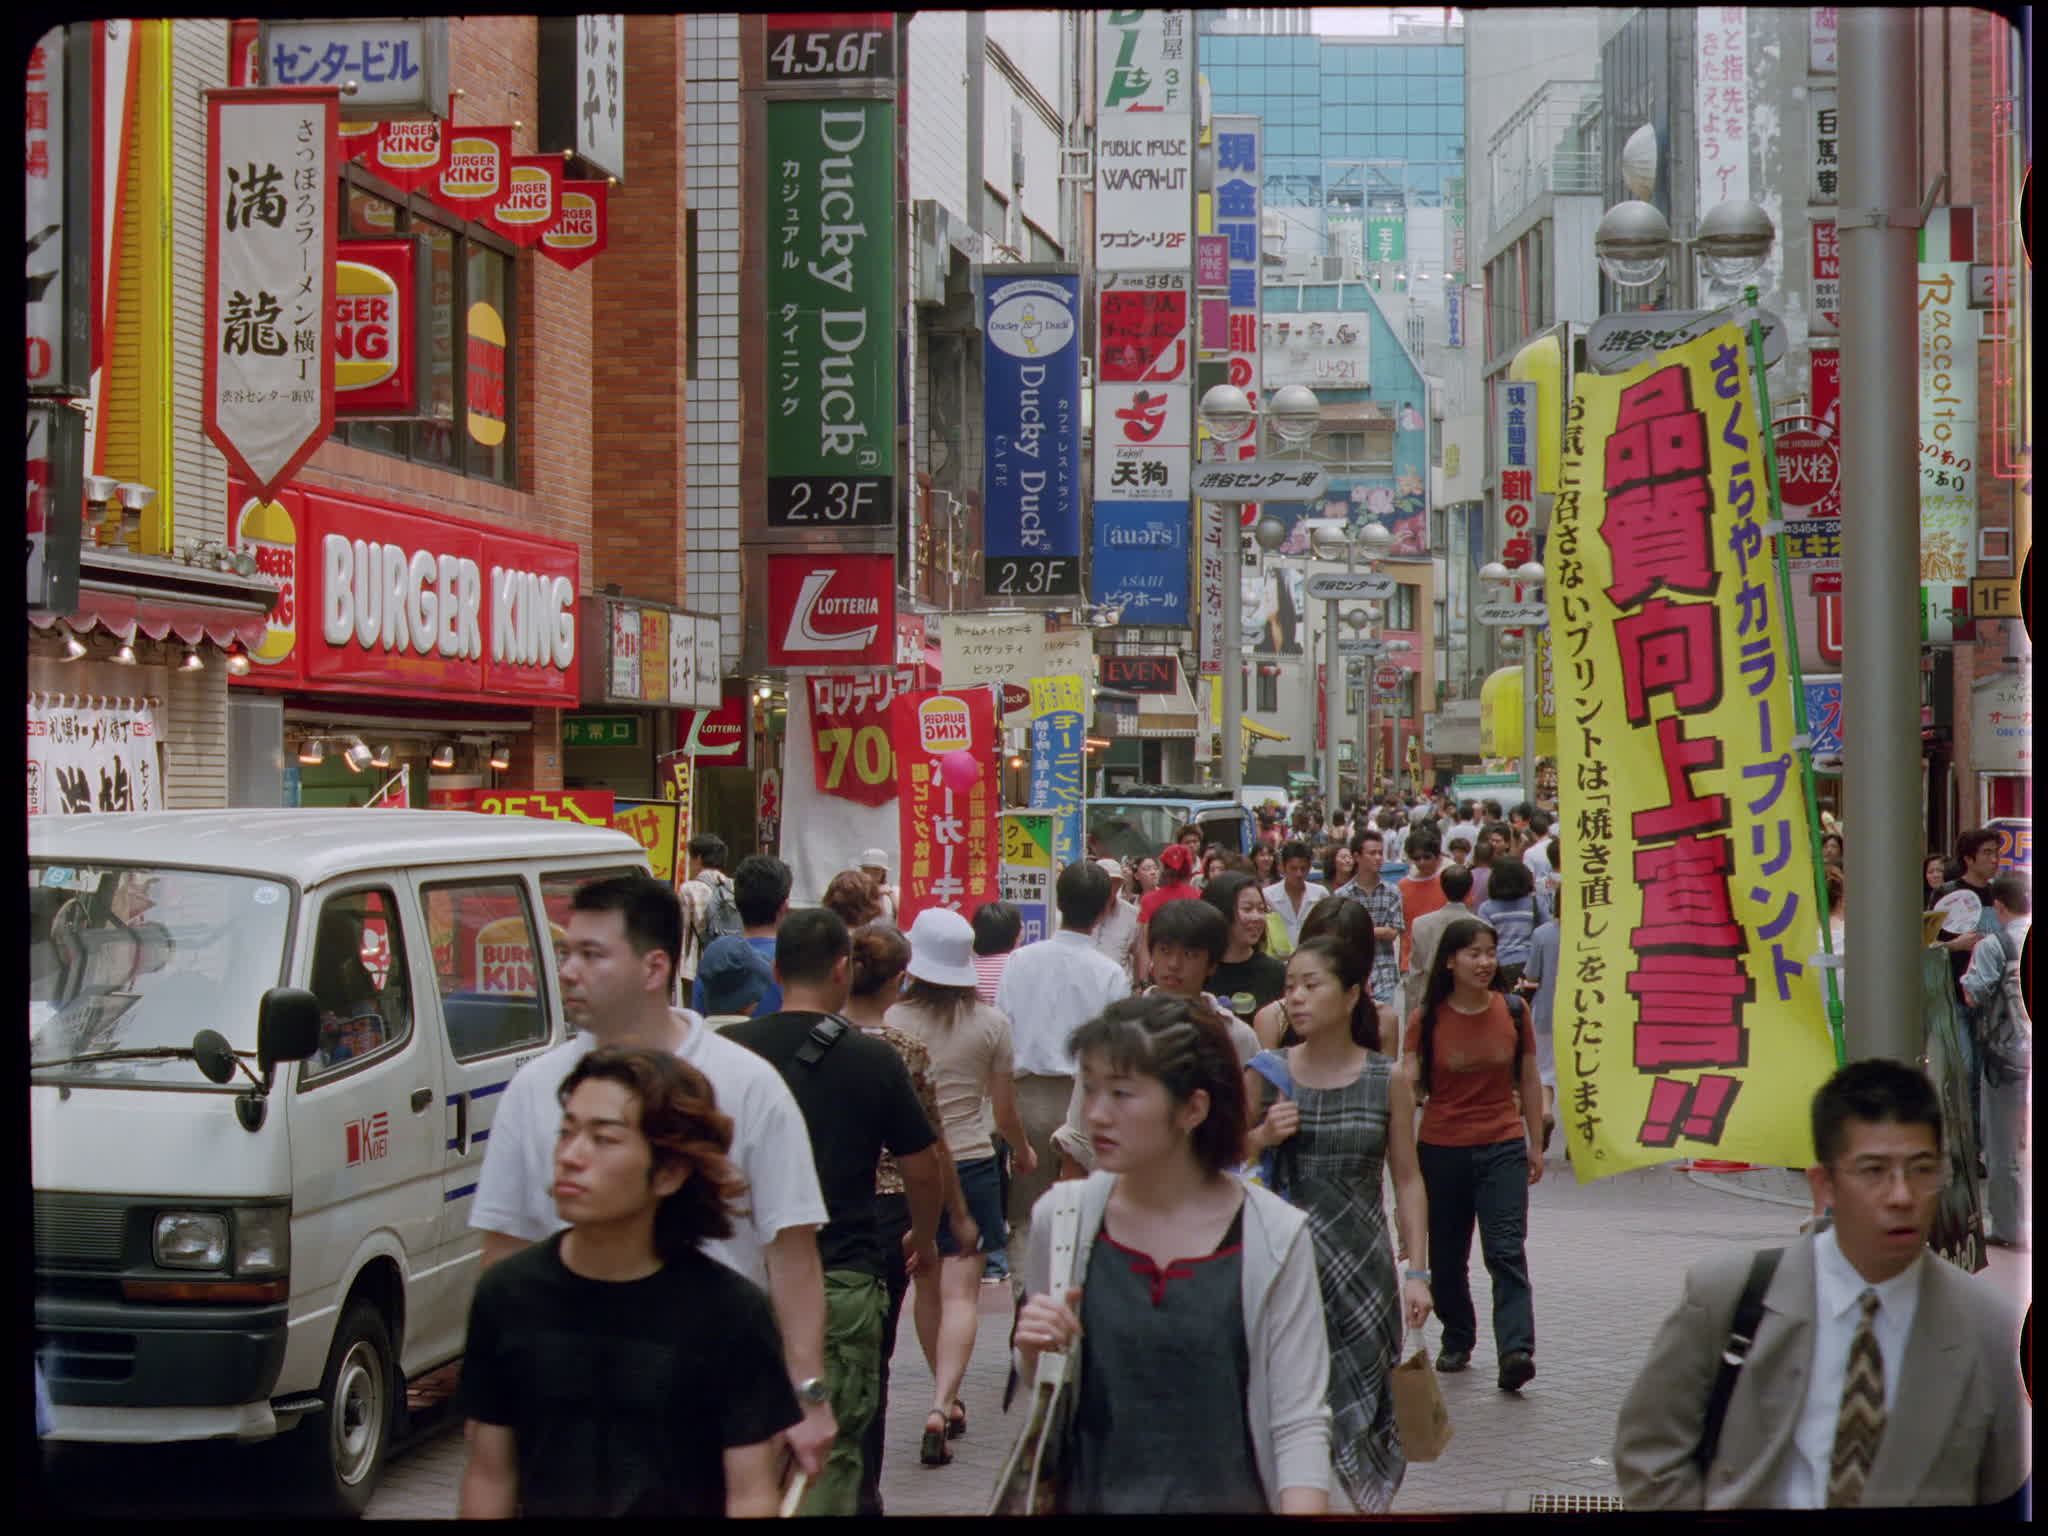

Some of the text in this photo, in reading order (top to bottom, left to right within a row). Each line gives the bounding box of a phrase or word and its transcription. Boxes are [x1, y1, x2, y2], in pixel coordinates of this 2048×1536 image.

[771, 31, 882, 74] 4.5.6F
[1161, 10, 1184, 59] 酒屋
[273, 40, 419, 83] センタービル
[382, 135, 436, 152] KING
[390, 124, 436, 136] URGER
[452, 155, 495, 166] URGER
[1101, 140, 1142, 157] PUBLIC
[443, 165, 495, 183] KING
[499, 192, 548, 209] KING
[294, 119, 316, 380] さっぽろラーメン横丁
[781, 159, 800, 417] カジュアル ダイニング
[808, 108, 868, 457] Ducky Duck
[336, 297, 389, 322] GER
[336, 324, 389, 360] NG
[1919, 273, 1963, 441] Raccolto
[1014, 364, 1047, 548] Ducky Duck
[1111, 460, 1169, 487] 天狗
[787, 482, 879, 520] 2.3F
[998, 560, 1066, 593] 2.3F
[324, 534, 482, 661] BURGER
[491, 565, 576, 671] KING
[817, 597, 879, 615] LOTTERIA
[1977, 587, 2012, 610] 1F
[1108, 662, 1169, 682] EVEN
[1710, 343, 1804, 1001] さくらやカラープリント
[814, 670, 916, 716] ロッテリア
[701, 724, 742, 734] LOTTERIA
[818, 725, 898, 790] 70
